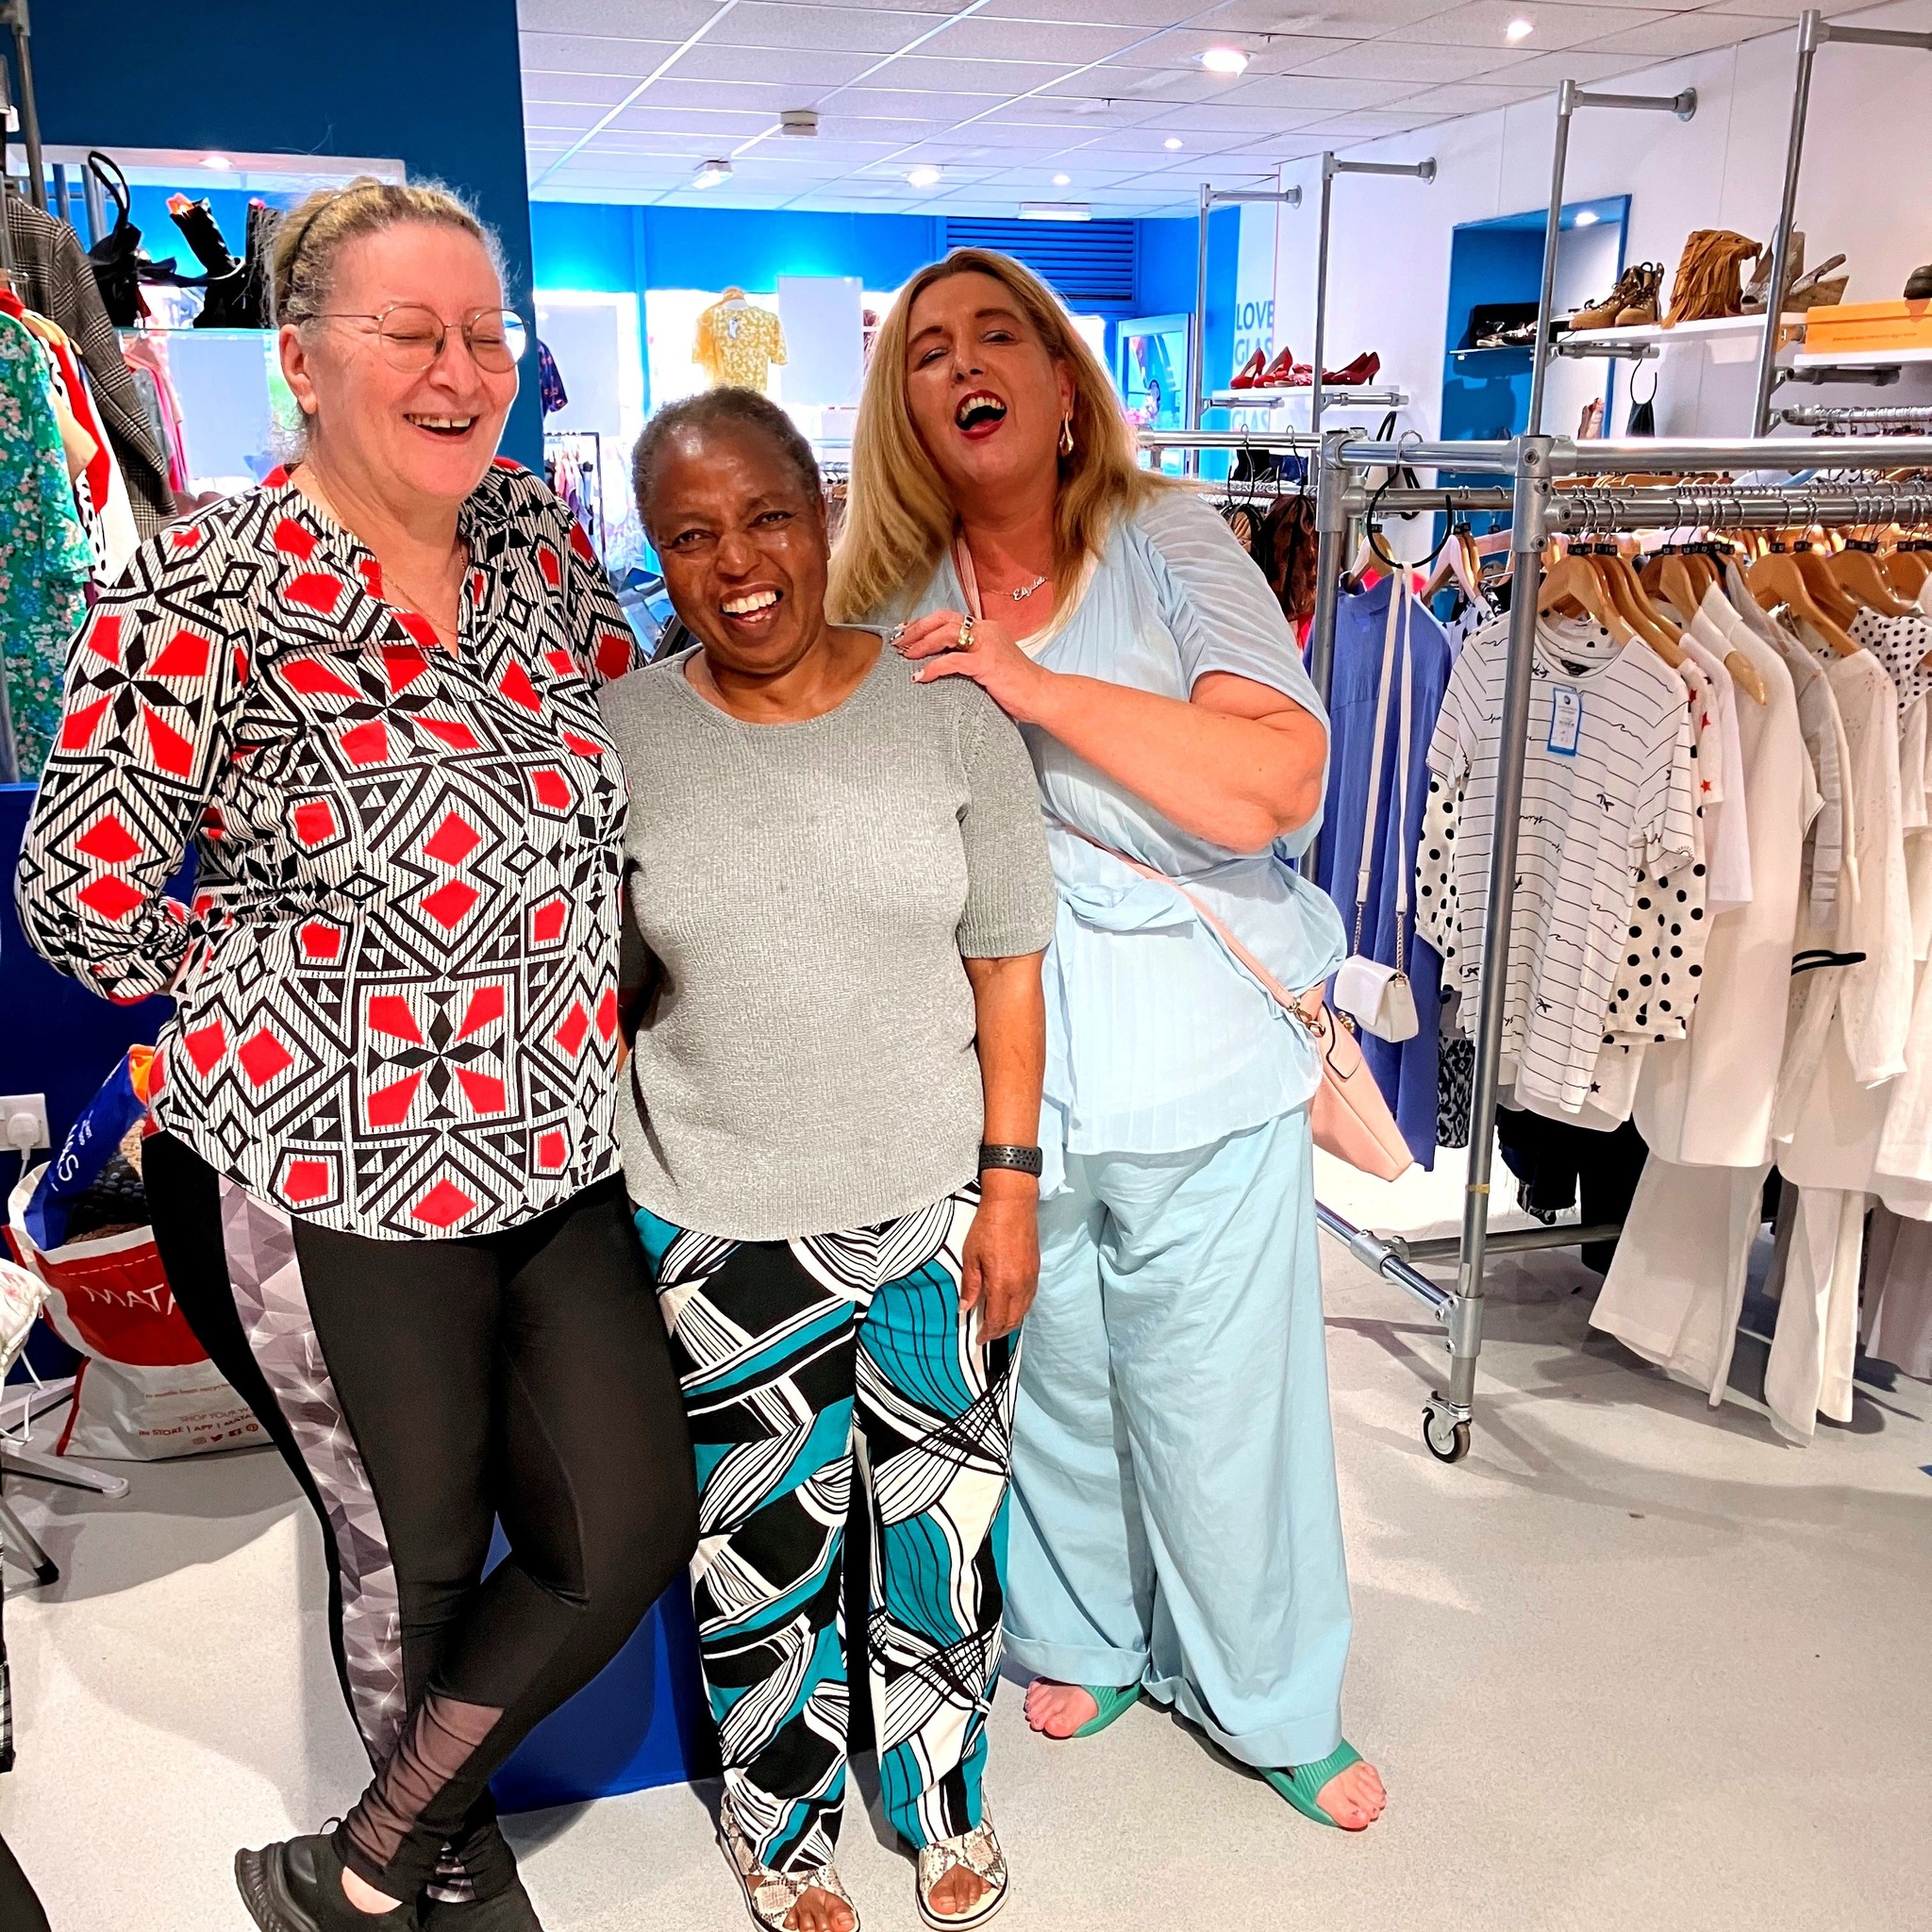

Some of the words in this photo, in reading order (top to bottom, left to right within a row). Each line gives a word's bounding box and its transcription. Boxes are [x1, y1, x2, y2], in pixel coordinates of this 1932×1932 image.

[1236, 300, 1274, 331] LOVE
[152, 1425, 183, 1436] STORE
[194, 1424, 213, 1432] APP
